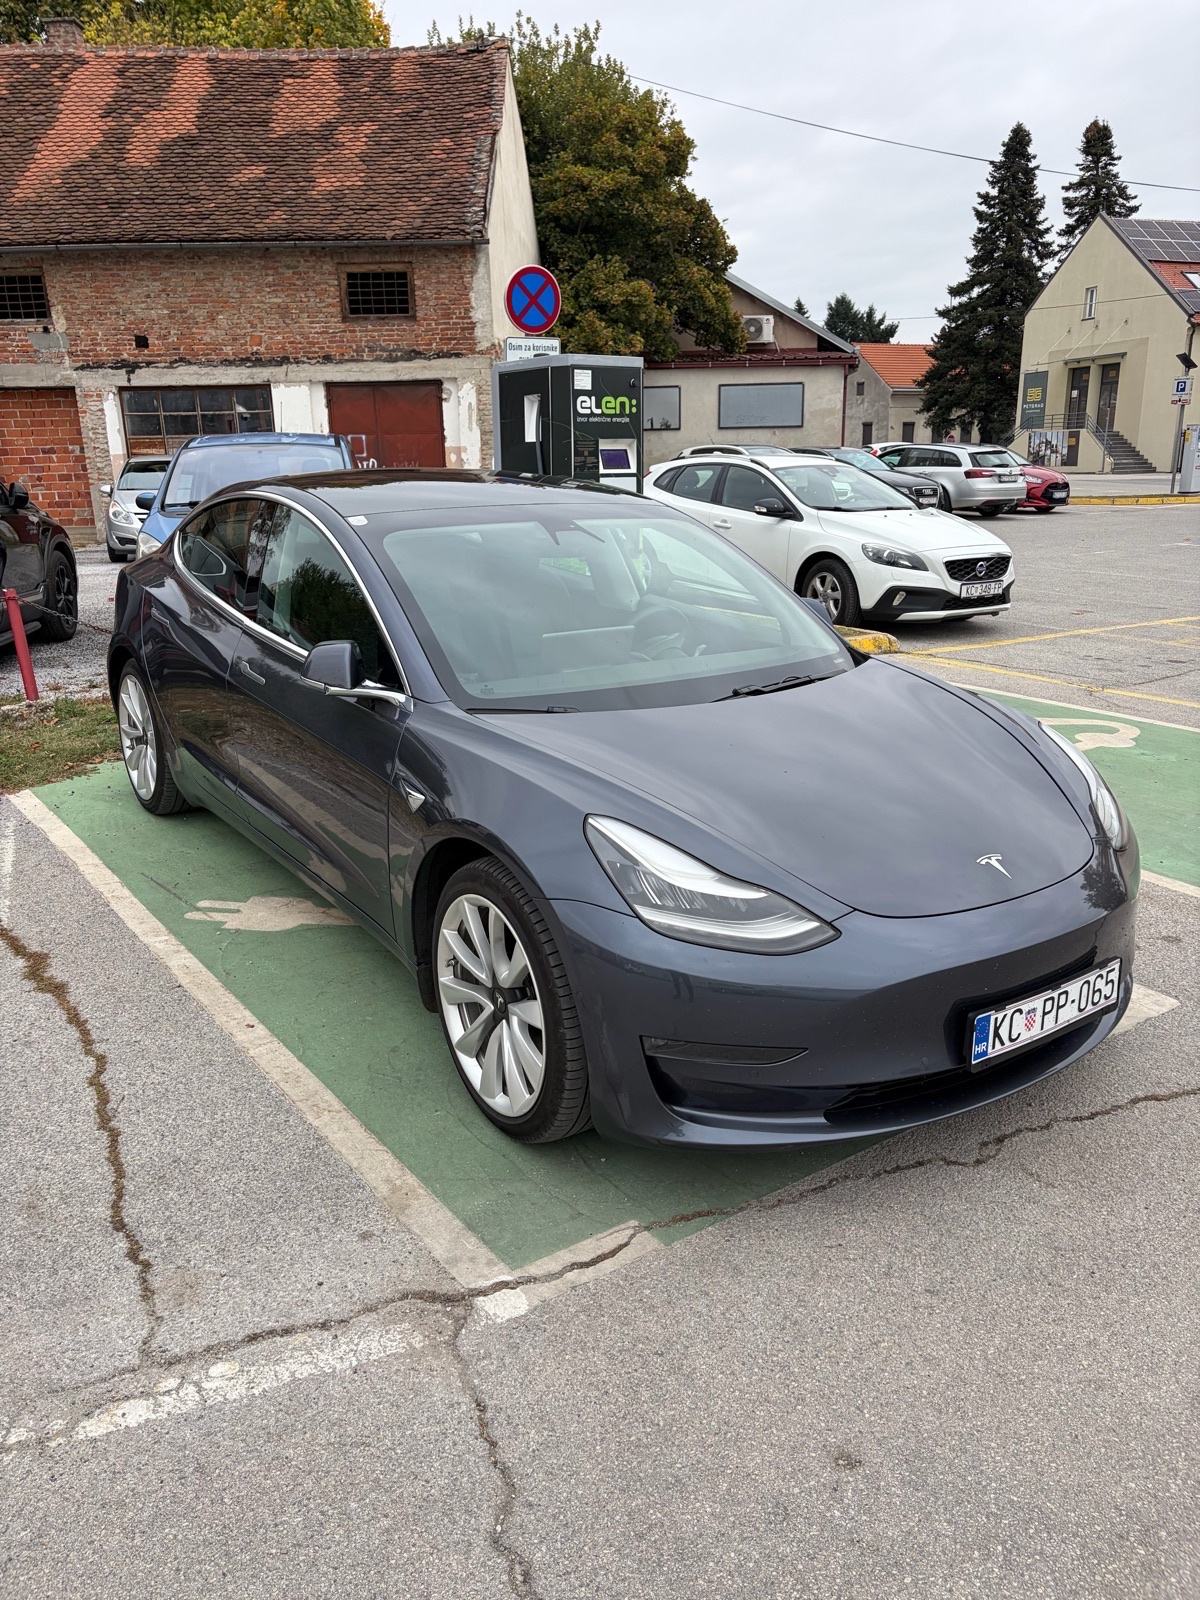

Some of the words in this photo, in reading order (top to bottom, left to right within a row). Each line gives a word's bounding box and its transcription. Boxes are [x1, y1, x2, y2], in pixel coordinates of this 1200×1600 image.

[508, 342, 523, 351] Osim
[532, 343, 558, 352] korisnike
[966, 585, 974, 596] KC
[991, 1008, 1023, 1051] KC
[1040, 968, 1116, 1031] PP-065
[974, 1042, 987, 1055] HR
